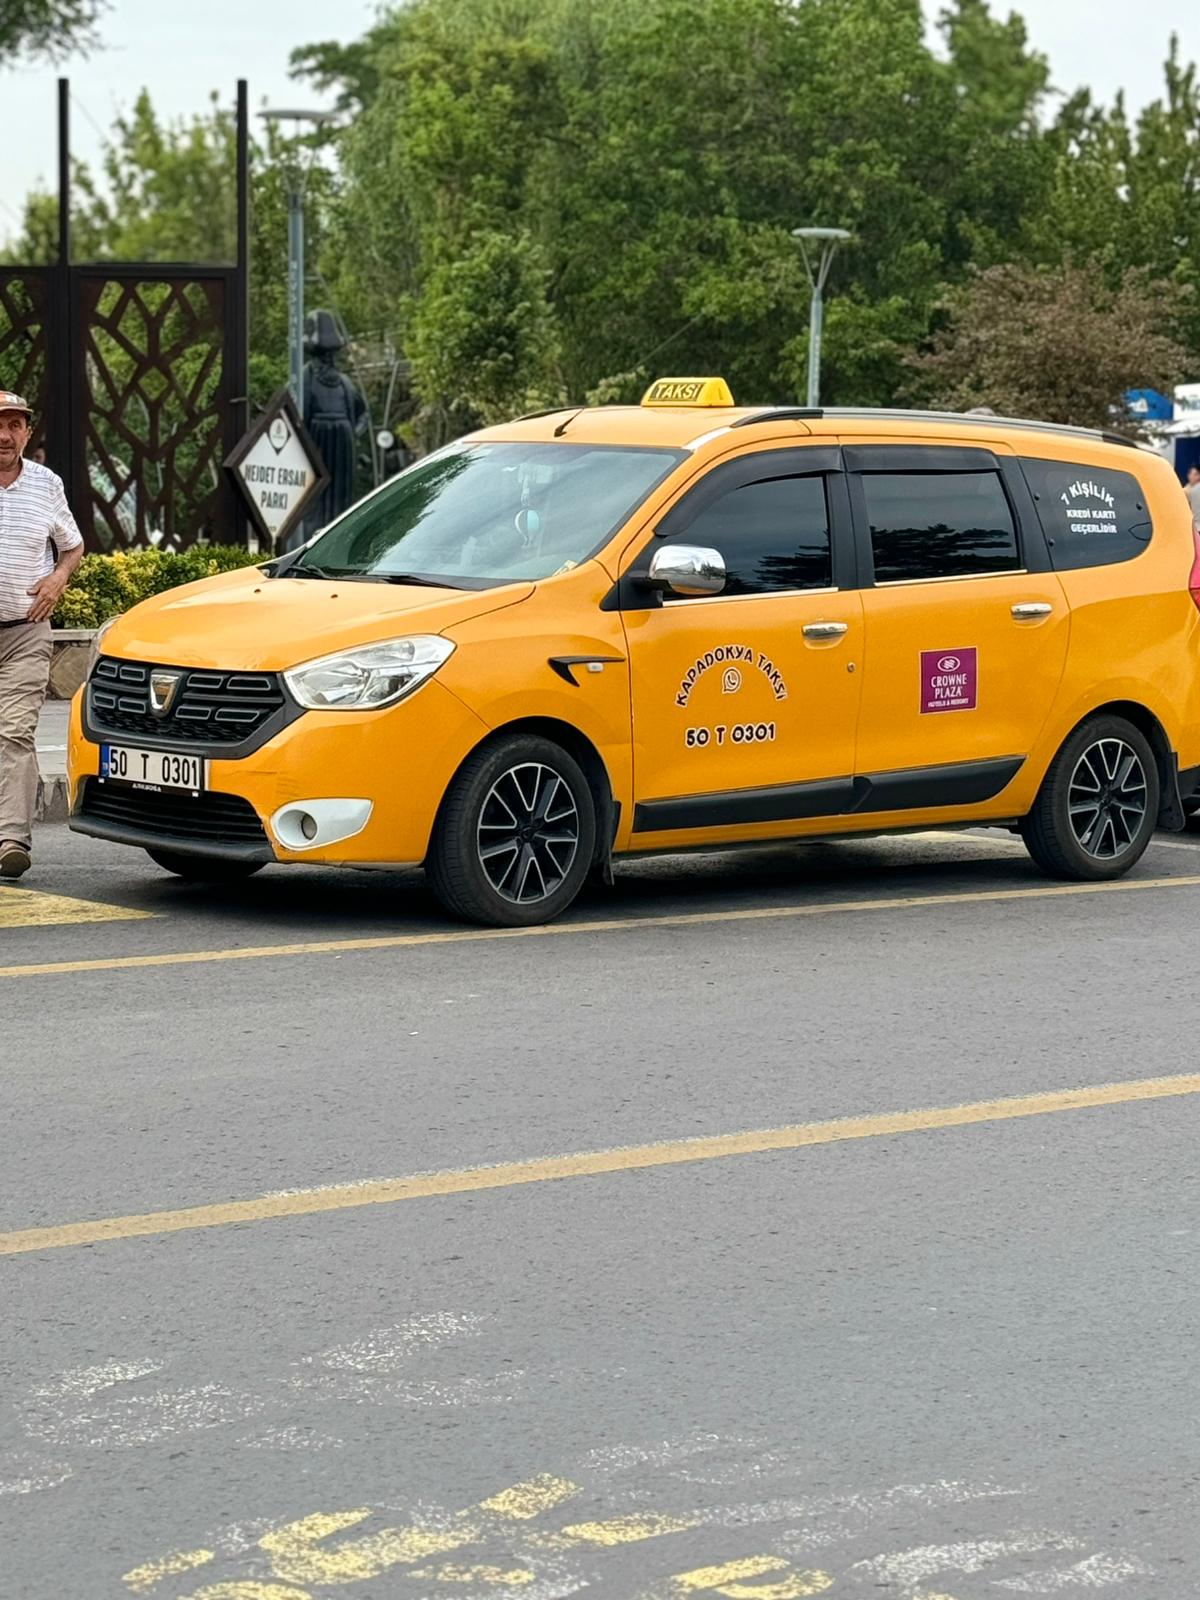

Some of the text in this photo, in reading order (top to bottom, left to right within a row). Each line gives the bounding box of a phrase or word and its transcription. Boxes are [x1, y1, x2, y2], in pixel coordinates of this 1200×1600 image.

[244, 464, 307, 488] NEJDET ERSAN
[1060, 480, 1115, 508] 7 KİŞİLİK
[1092, 510, 1117, 519] KARTI
[675, 645, 754, 707] KAPADOKYA
[931, 673, 968, 688] CROWNE
[934, 686, 963, 699] PLAZA
[686, 722, 775, 747] 50 T 0301
[109, 748, 128, 777] 50
[140, 753, 150, 780] T
[162, 755, 198, 787] 0301
